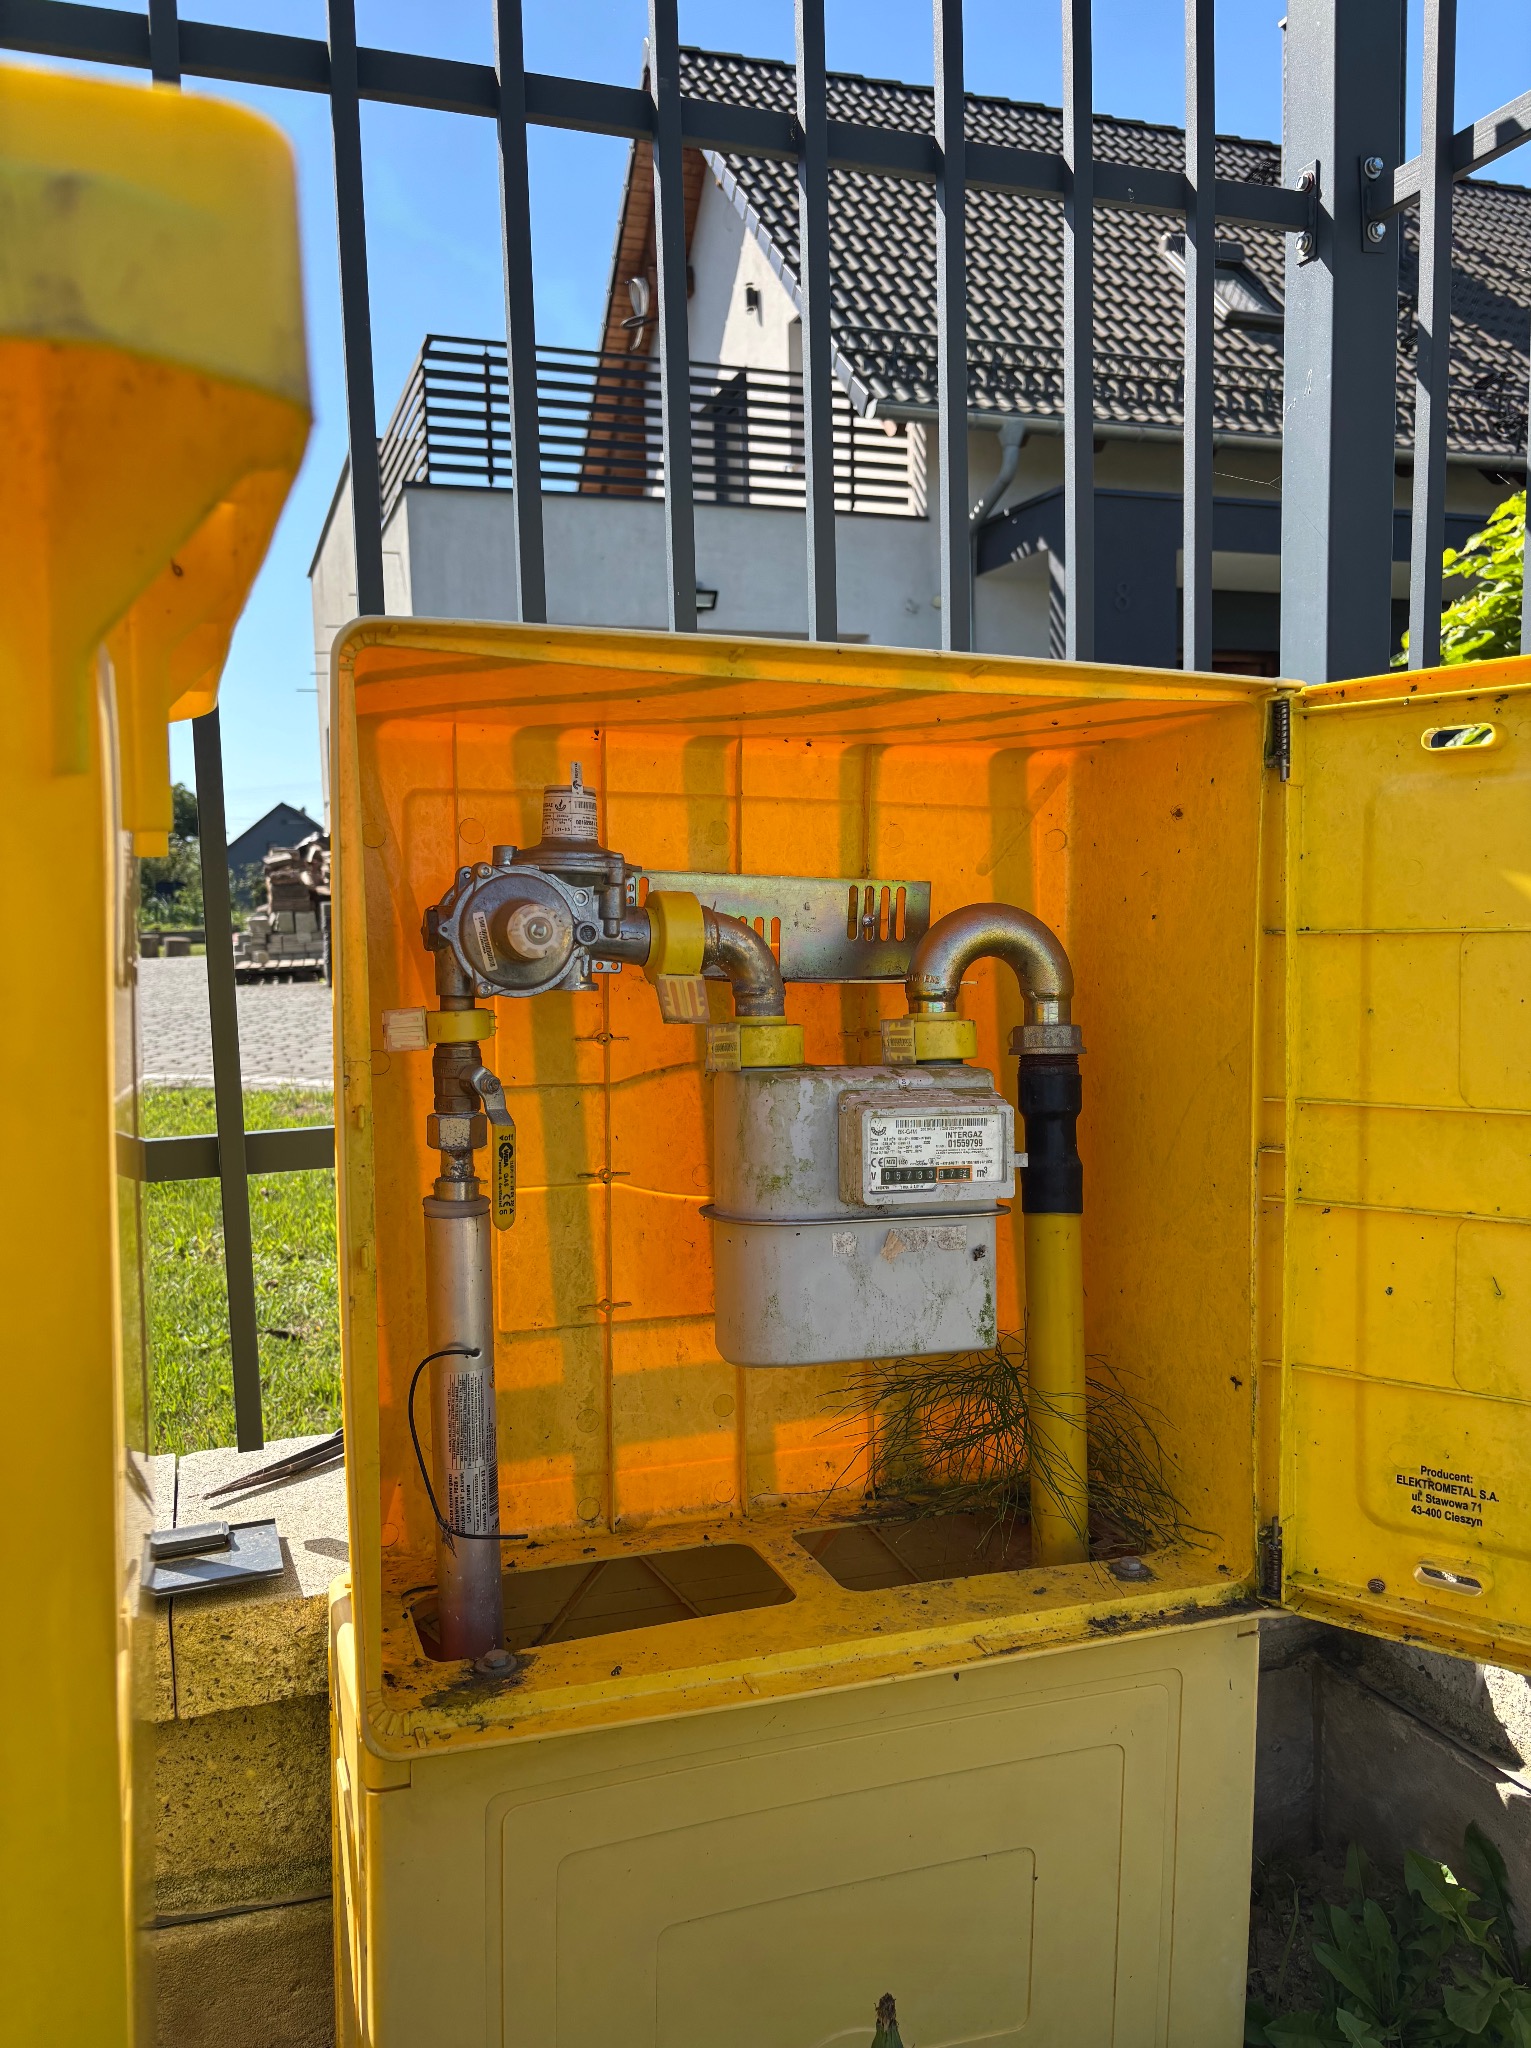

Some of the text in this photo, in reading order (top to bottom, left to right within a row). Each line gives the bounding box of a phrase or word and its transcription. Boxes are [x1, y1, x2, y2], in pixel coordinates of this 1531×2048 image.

[945, 1131, 983, 1139] INTERGAZ
[948, 1139, 983, 1147] 01559799
[870, 1172, 877, 1180] V
[1420, 1465, 1473, 1483] Producent:
[1396, 1474, 1500, 1502] ELEKTROMETAL S.A.
[1425, 1494, 1469, 1511] Stawowa
[1470, 1502, 1482, 1513] 71
[1410, 1505, 1483, 1528] 43-400 Cieszyn
